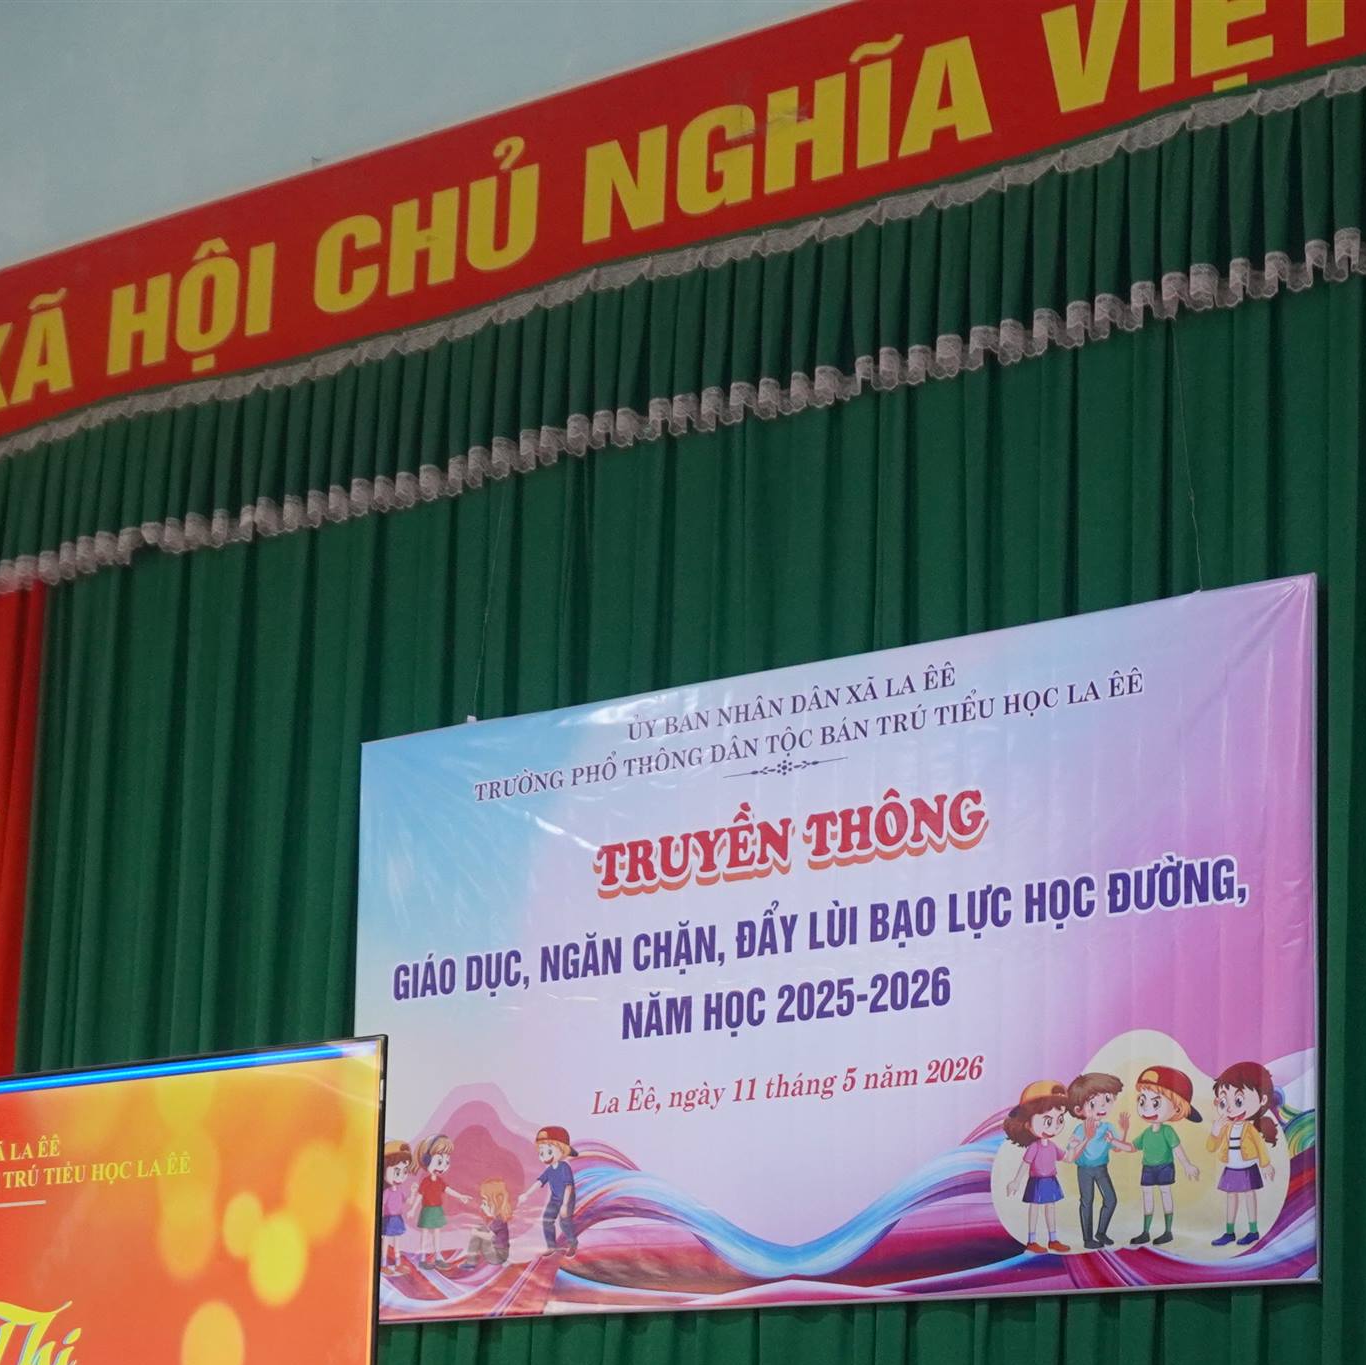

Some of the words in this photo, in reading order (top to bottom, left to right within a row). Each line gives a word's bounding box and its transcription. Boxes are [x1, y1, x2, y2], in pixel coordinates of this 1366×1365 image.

[106, 238, 278, 376] HỘI
[312, 137, 541, 315] CHỦ
[581, 34, 994, 245] NGHĨA
[474, 769, 564, 801] TRƯỜNG
[570, 751, 618, 786] PHỔ
[623, 747, 704, 779] THÔNG
[710, 734, 760, 764] DÂN
[765, 726, 814, 757] TỘC
[819, 716, 870, 746] BÁN
[875, 703, 927, 736] TRÚ
[934, 689, 996, 727] TIỂU
[1002, 687, 1060, 719] HỌC
[1066, 679, 1103, 705] LA
[1108, 667, 1144, 698] ÊÊ
[628, 714, 657, 742] ỦY
[664, 709, 711, 737] BAN
[716, 696, 783, 728] NHÂN
[790, 685, 841, 715] DÂN
[845, 676, 879, 705] XÃ
[884, 675, 916, 699] LA
[923, 661, 956, 691] ÊÊ
[594, 801, 794, 896] TRUYỀN
[804, 788, 988, 868] THÔNG
[393, 953, 457, 1002] GIÁO
[465, 949, 531, 998] DỤC,
[539, 931, 623, 983] NGĂN
[632, 920, 725, 975] CHẶN,
[735, 900, 799, 960] ĐẨY
[809, 901, 858, 950] LÙI
[869, 896, 936, 949] BẠO
[947, 884, 1012, 939] LỰC
[1024, 876, 1096, 930] HỌC
[1107, 855, 1248, 915] ĐƯỜNG,
[621, 992, 693, 1040] NĂM
[703, 986, 766, 1038] HỌC
[776, 966, 952, 1024] 2025-2026
[591, 1090, 621, 1115] La
[627, 1079, 662, 1114] Êê,
[667, 1081, 726, 1112] ngày
[731, 1078, 758, 1102] 11
[765, 1072, 838, 1100] tháng
[842, 1067, 859, 1093] 5
[862, 1064, 919, 1091] năm
[923, 1055, 985, 1085] 2026
[3, 1164, 39, 1189] TRÚ
[91, 1161, 132, 1185] HỌC
[137, 1159, 162, 1178] LA
[166, 1151, 192, 1175] ÊÊ
[10, 1142, 34, 1161] LA
[37, 1134, 61, 1159] ÊÊ
